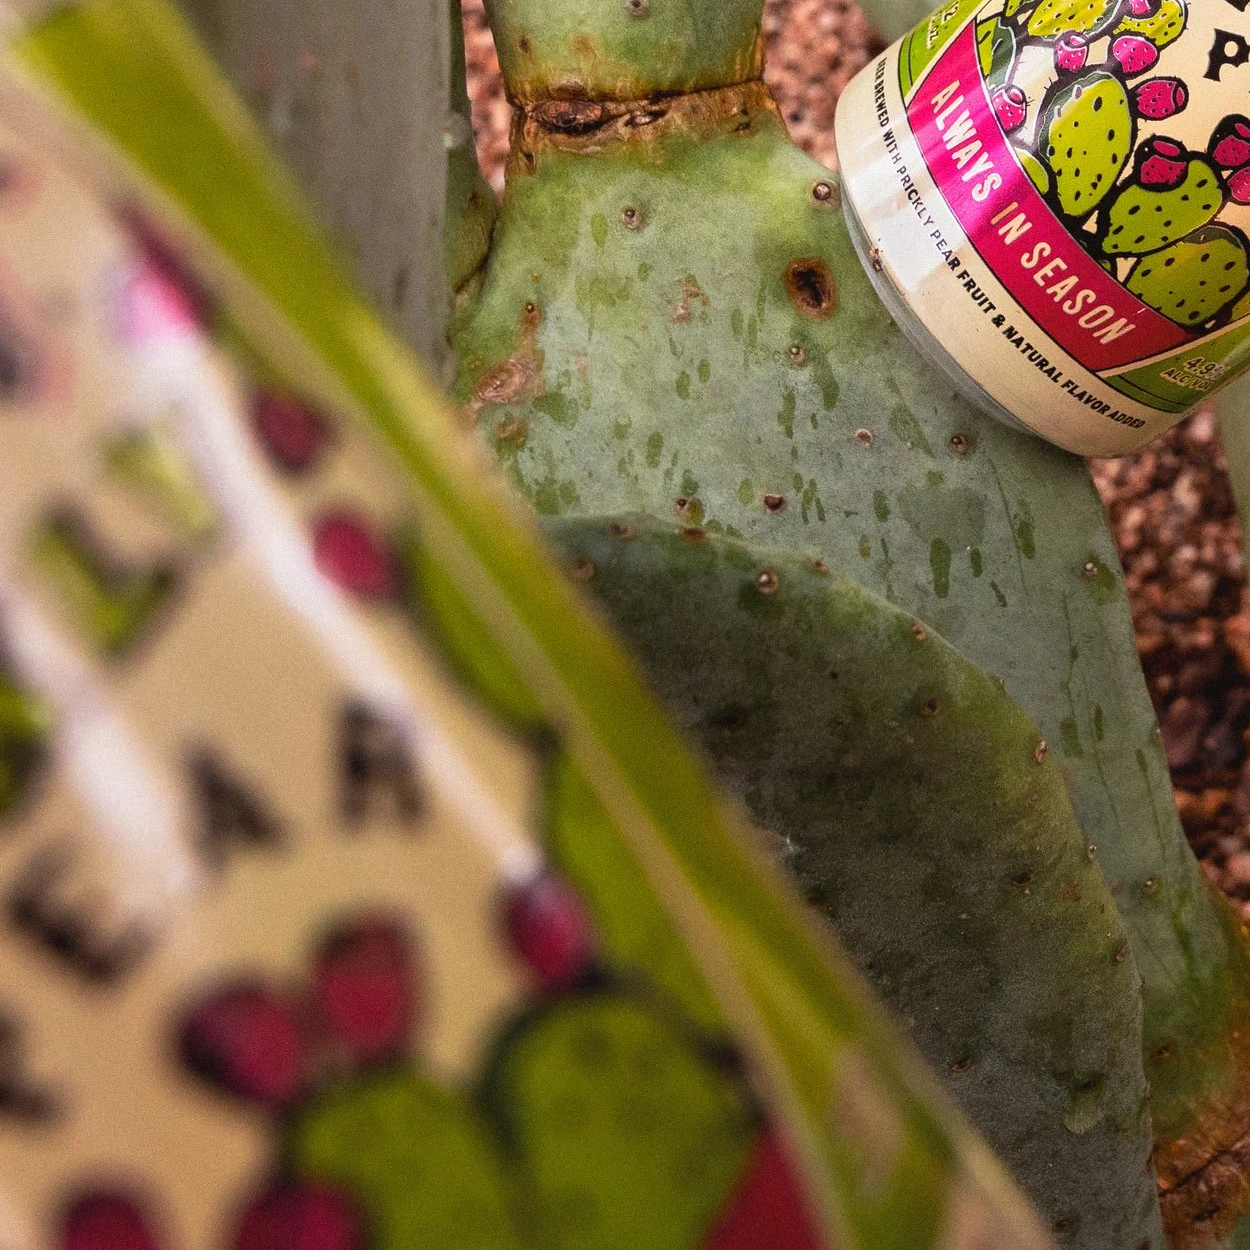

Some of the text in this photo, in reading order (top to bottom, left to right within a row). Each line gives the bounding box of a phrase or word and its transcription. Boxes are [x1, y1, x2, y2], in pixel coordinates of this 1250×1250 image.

[874, 56, 1147, 430] BEER BREWED WITH PRICKLY PEAR FRUIT & NATURAL FLAVOR ADDED
[930, 79, 1136, 345] ALWAYS IN SEASON
